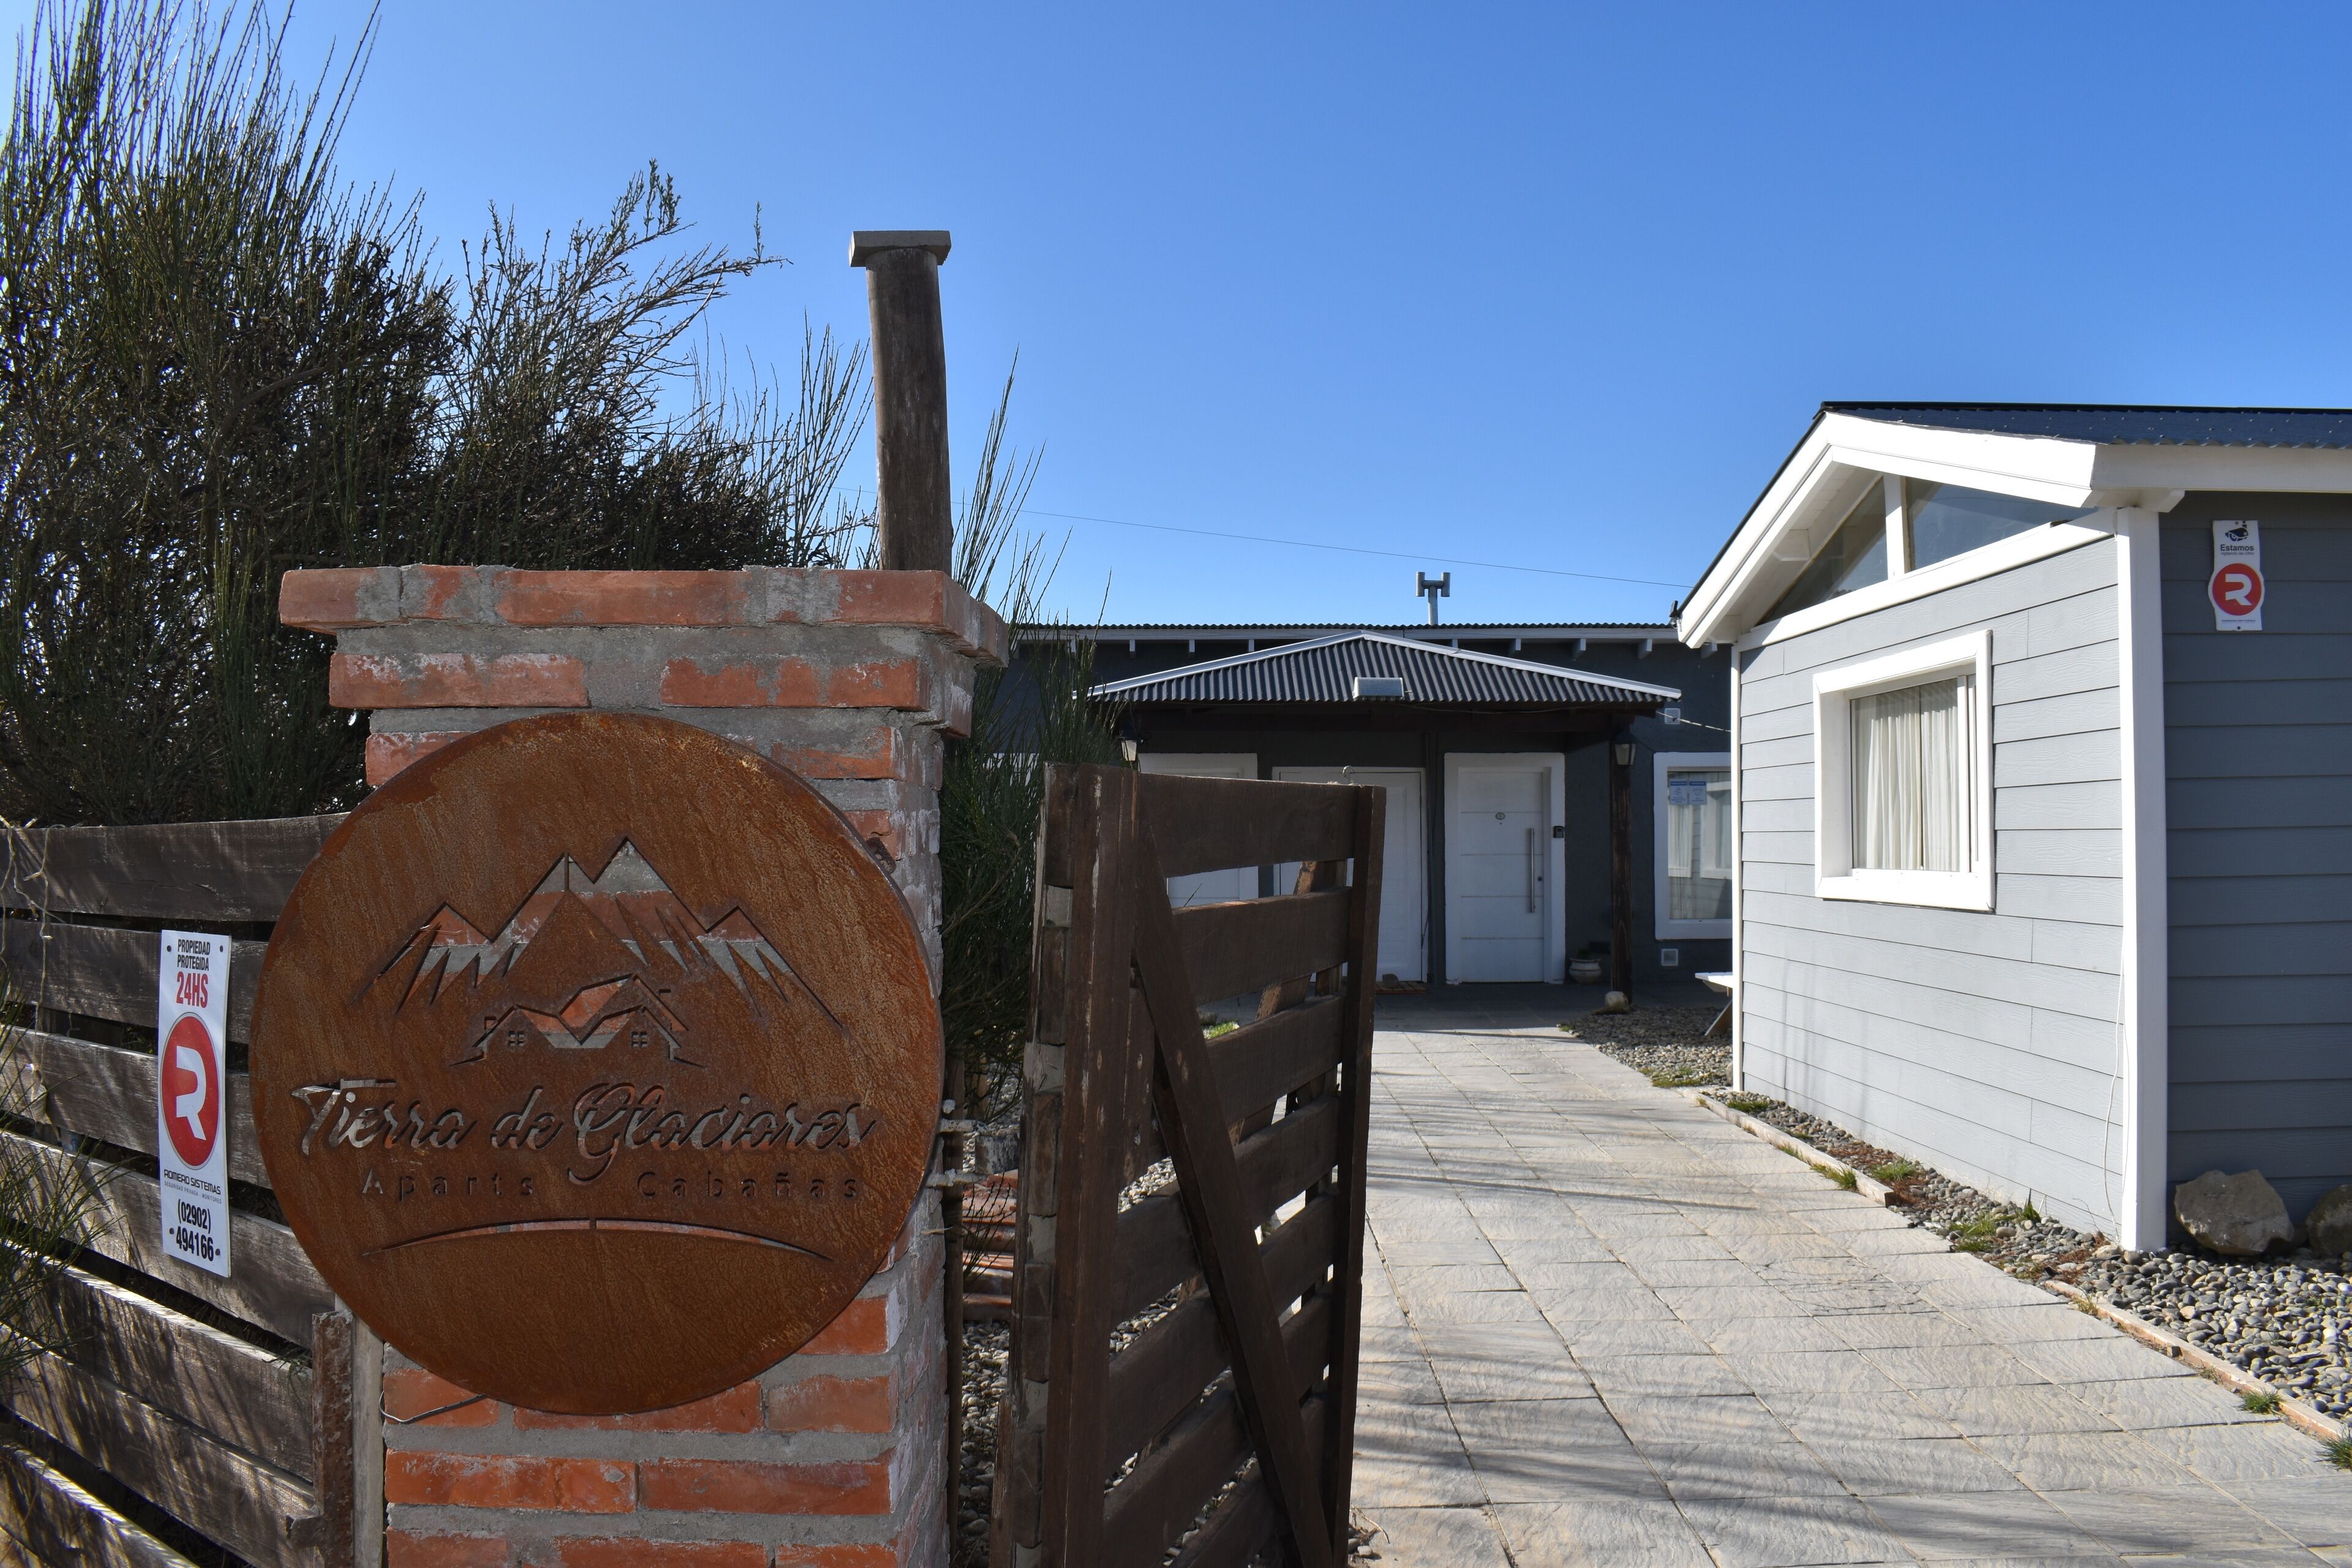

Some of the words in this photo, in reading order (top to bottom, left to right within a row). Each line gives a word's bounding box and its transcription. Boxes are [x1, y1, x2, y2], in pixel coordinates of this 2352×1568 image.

[177, 938, 211, 956] PROPIEDAD
[177, 954, 209, 971] PROTEGIDA
[176, 971, 208, 1008] 24HS
[176, 1046, 206, 1140] R
[291, 1079, 479, 1156] Tierra
[491, 1085, 564, 1150] de
[567, 1082, 877, 1186] Glaciares
[164, 1169, 190, 1185] ROMERO
[190, 1177, 221, 1195] SISTEMAS
[164, 1180, 183, 1191] SEGURIDAD
[362, 1168, 534, 1202] Aparts
[637, 1170, 858, 1198] Cabañas
[178, 1198, 211, 1234] (02902)
[176, 1226, 214, 1262] 494166
